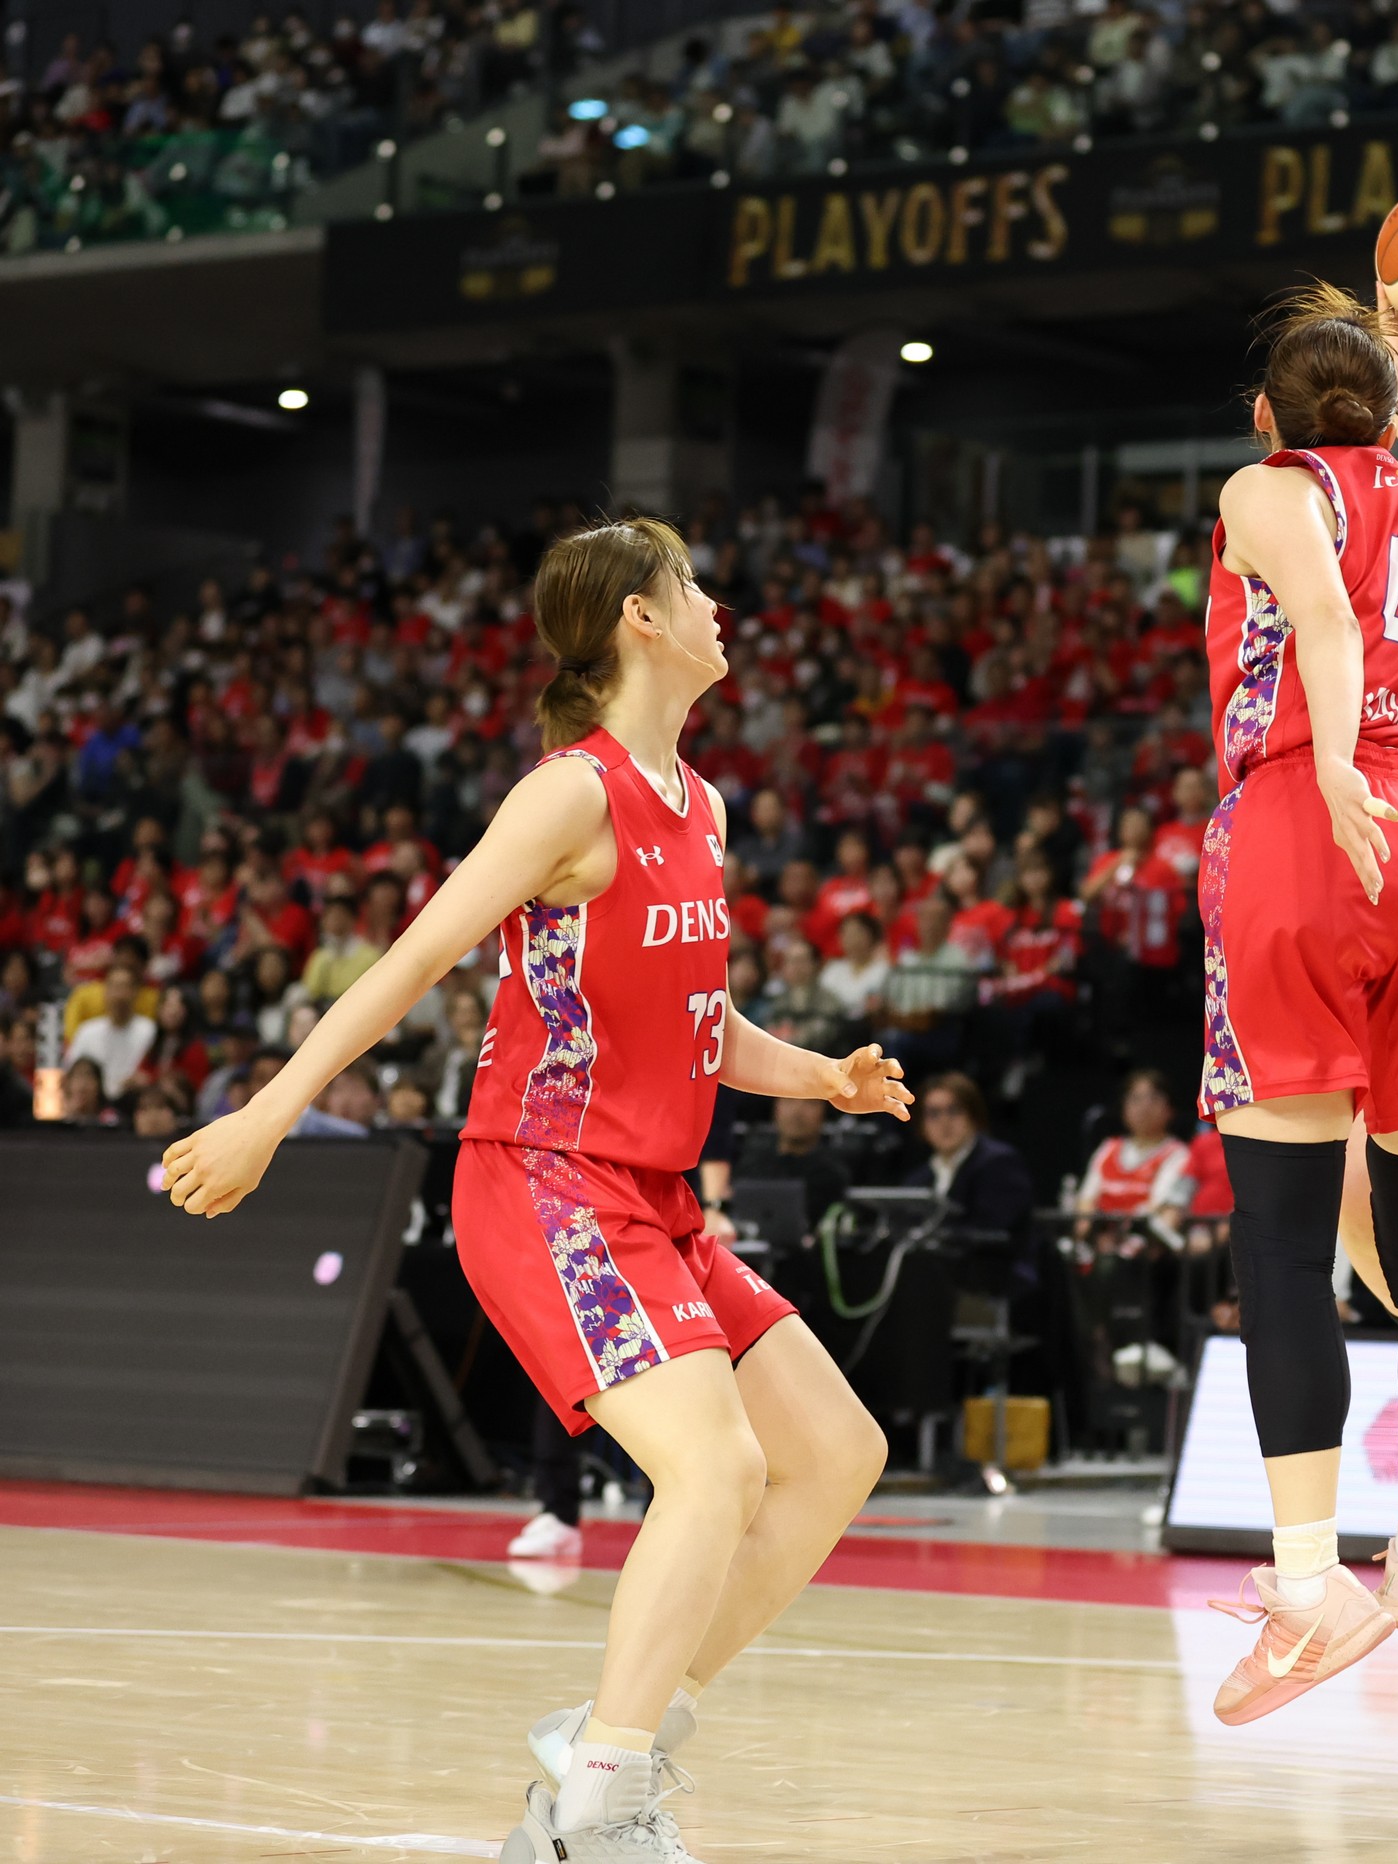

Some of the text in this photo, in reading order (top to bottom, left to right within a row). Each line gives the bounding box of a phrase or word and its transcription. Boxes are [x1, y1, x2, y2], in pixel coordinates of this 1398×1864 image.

[727, 164, 1070, 287] PLAYOFFS
[641, 897, 731, 948] DENS
[671, 1301, 716, 1323] KARI
